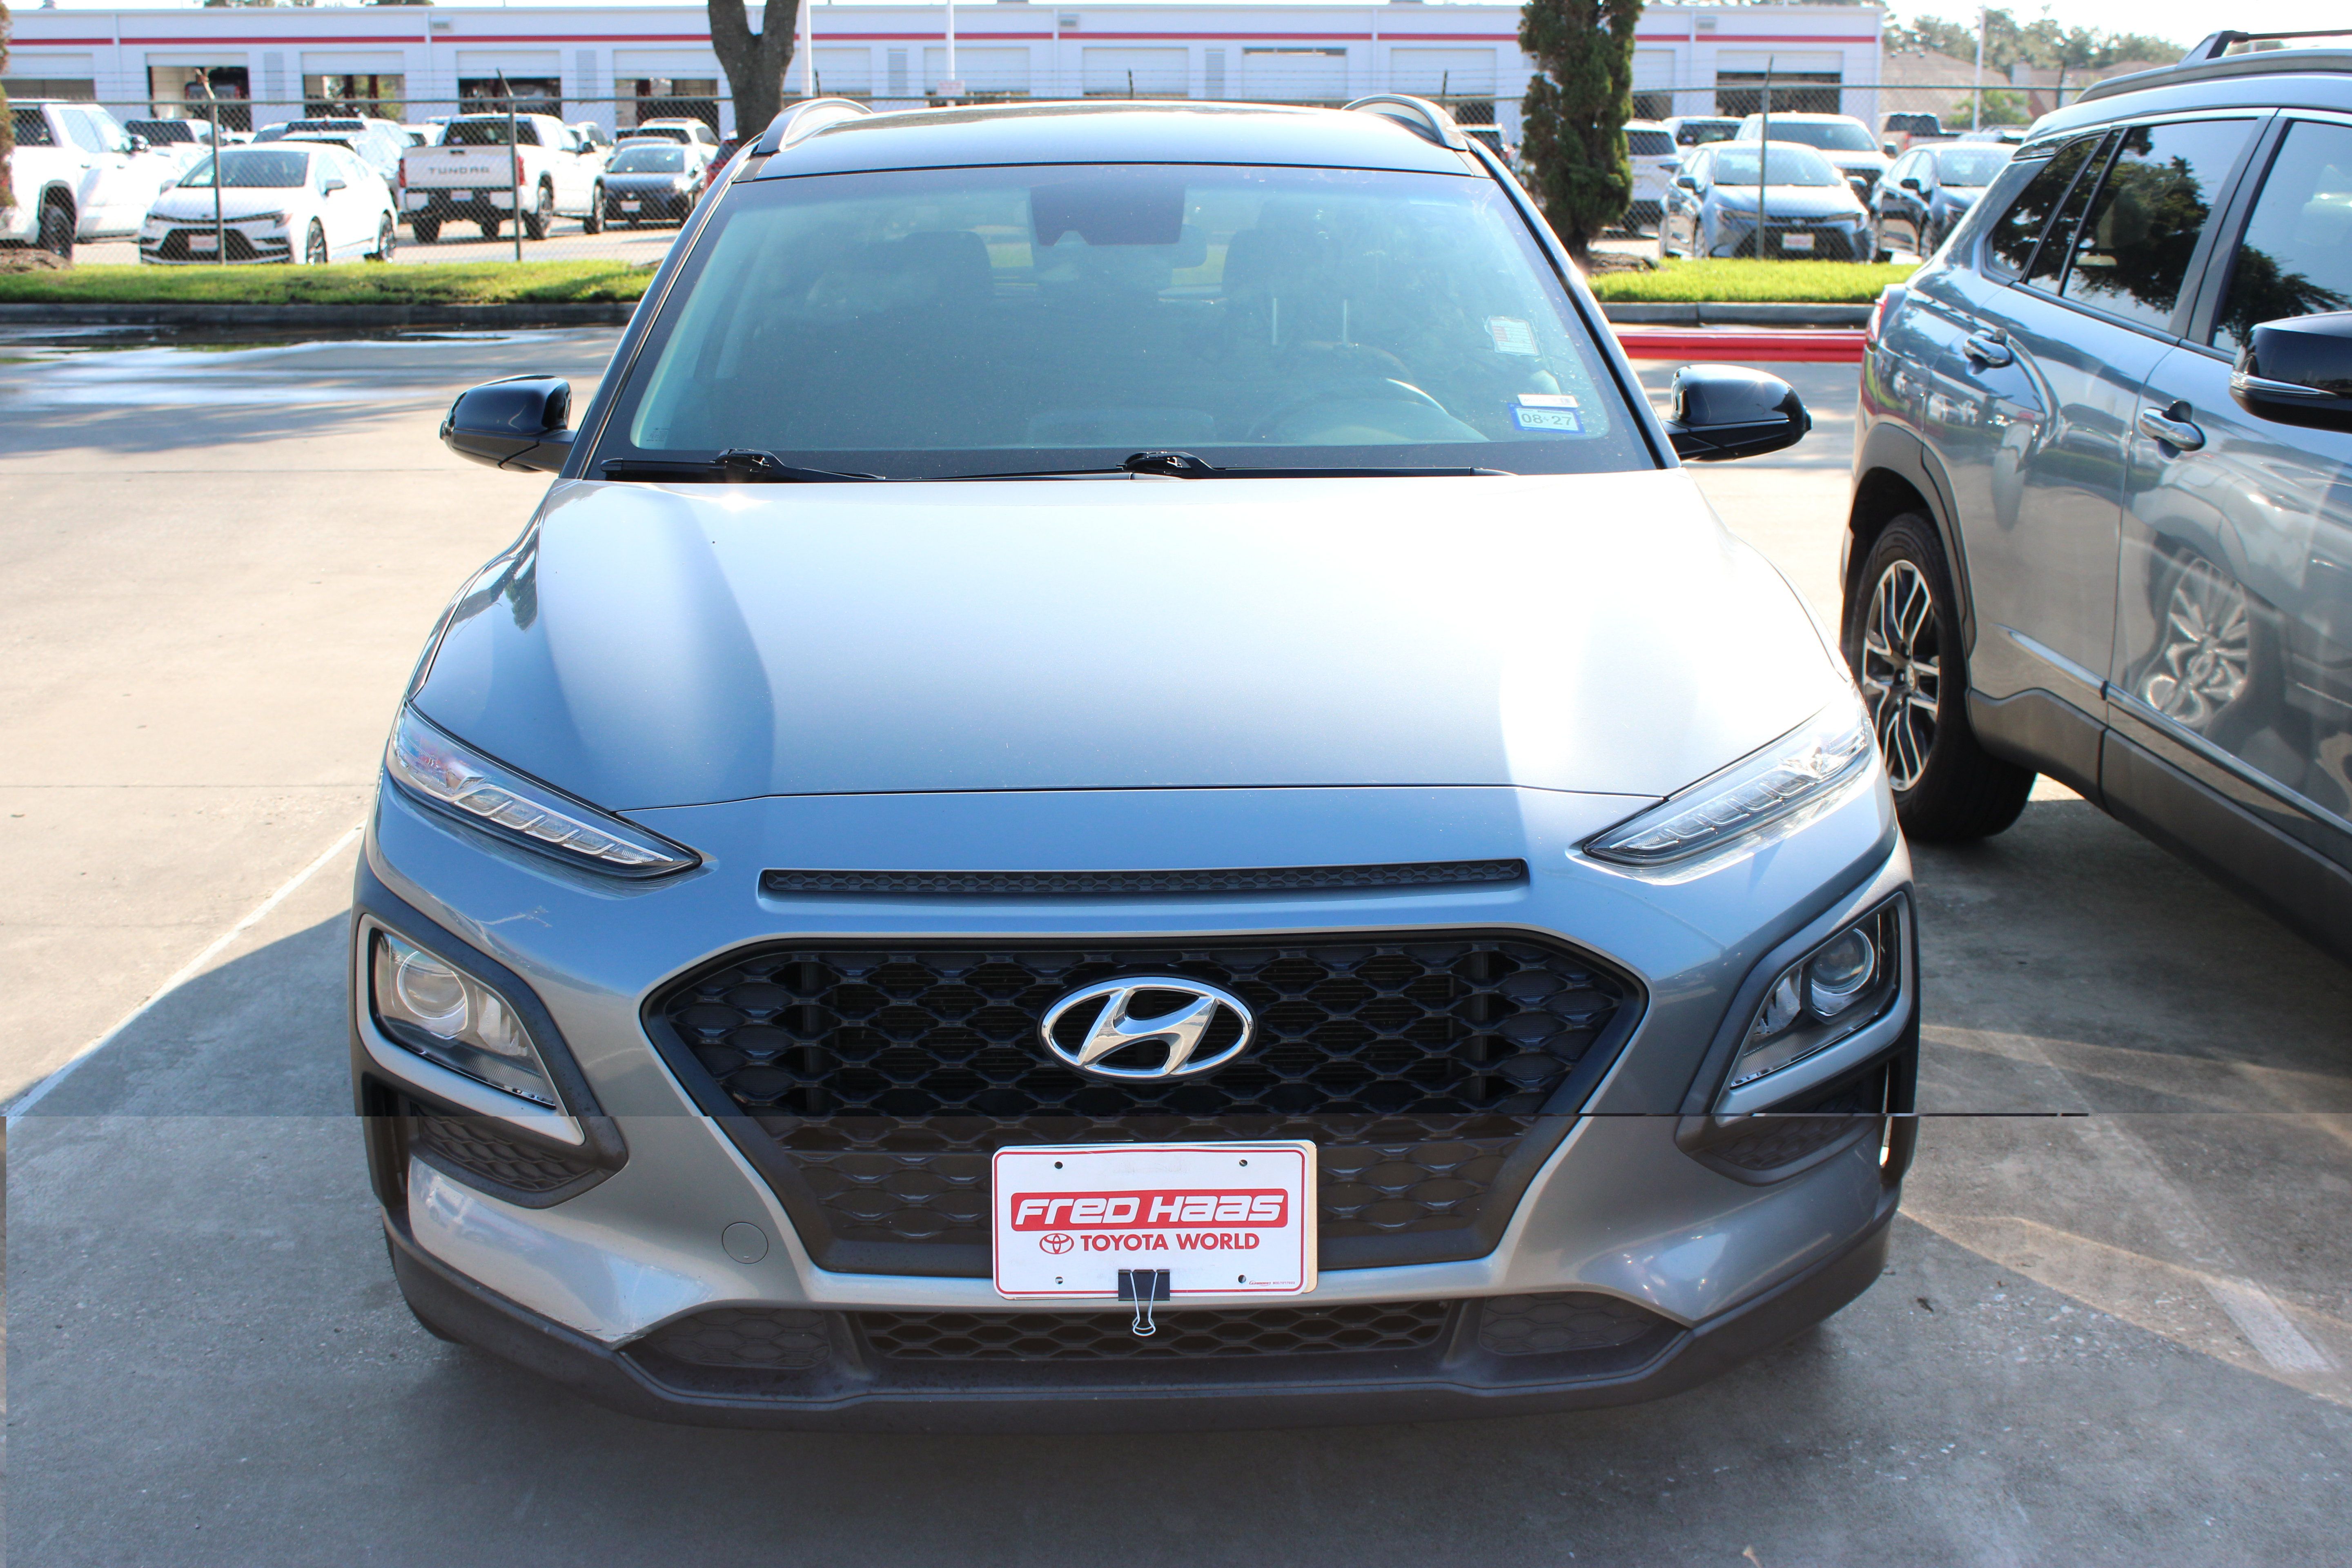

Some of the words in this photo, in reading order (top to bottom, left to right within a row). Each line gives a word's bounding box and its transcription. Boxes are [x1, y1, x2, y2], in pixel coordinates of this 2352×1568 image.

[1521, 413, 1544, 424] 08
[1551, 415, 1572, 425] 27
[1080, 1234, 1169, 1251] TOYOTA
[1176, 1233, 1260, 1250] WORLD
